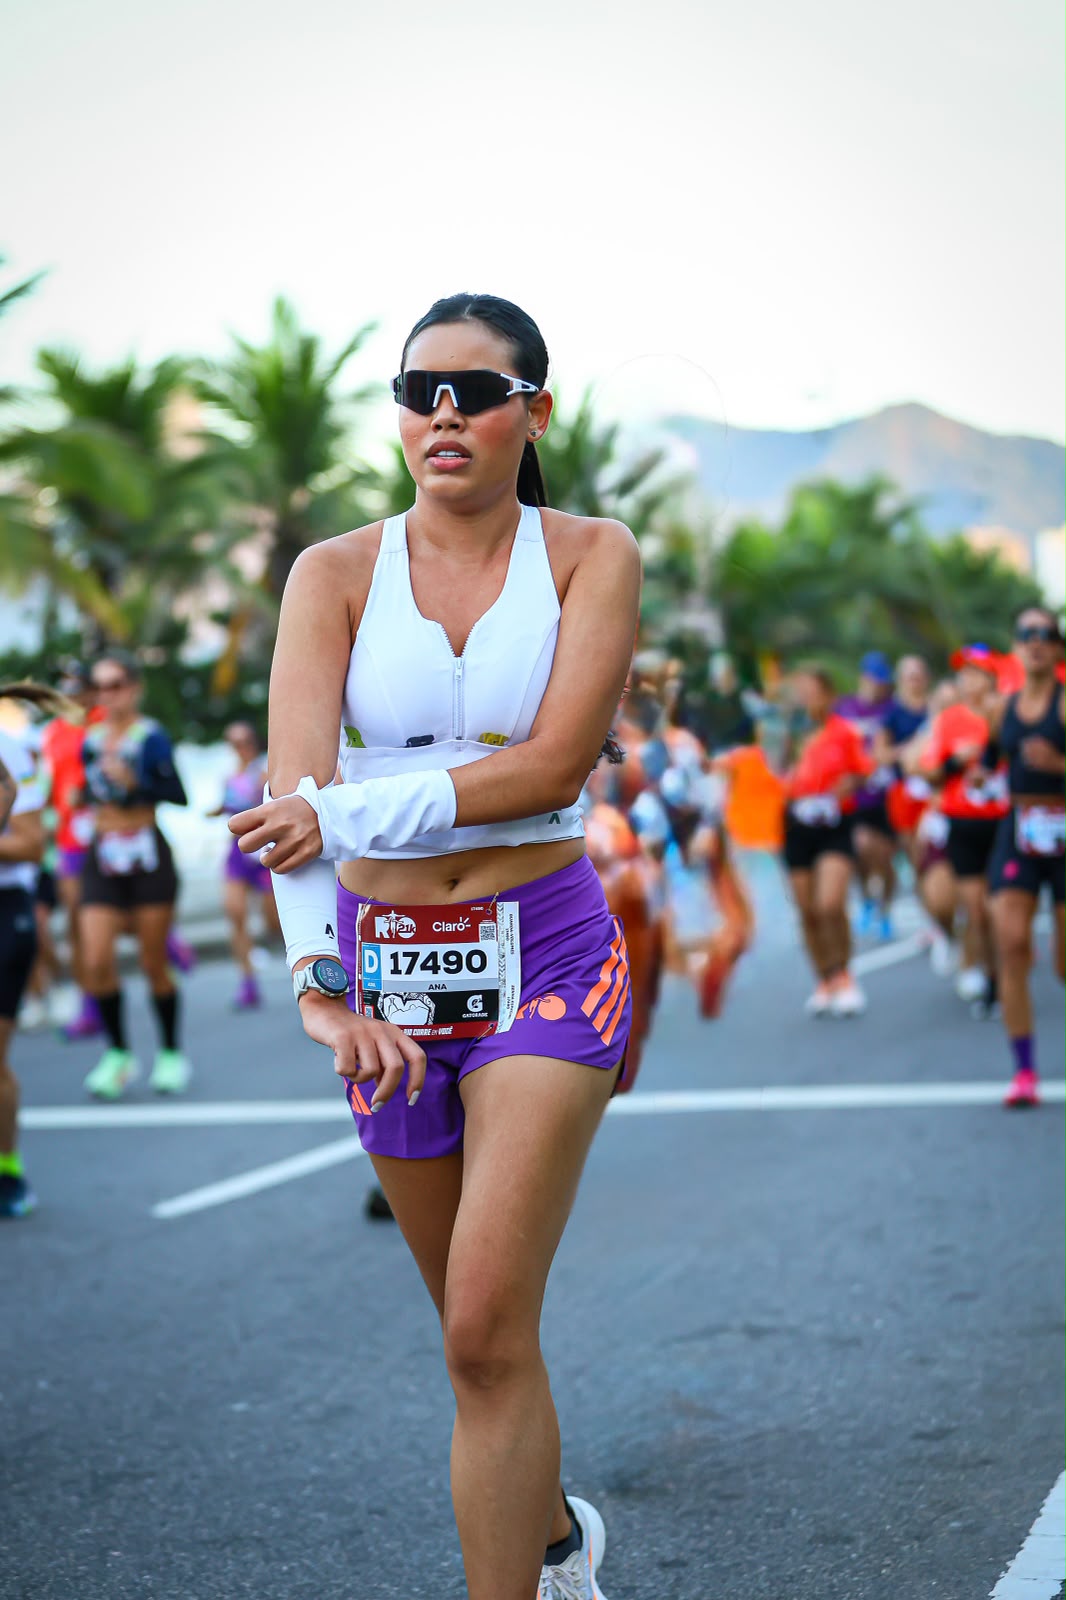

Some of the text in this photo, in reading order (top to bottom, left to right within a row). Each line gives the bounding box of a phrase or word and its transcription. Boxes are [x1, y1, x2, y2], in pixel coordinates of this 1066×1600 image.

[432, 918, 468, 932] Claro
[364, 949, 379, 974] D
[390, 949, 488, 975] 17490
[428, 983, 447, 991] ANA
